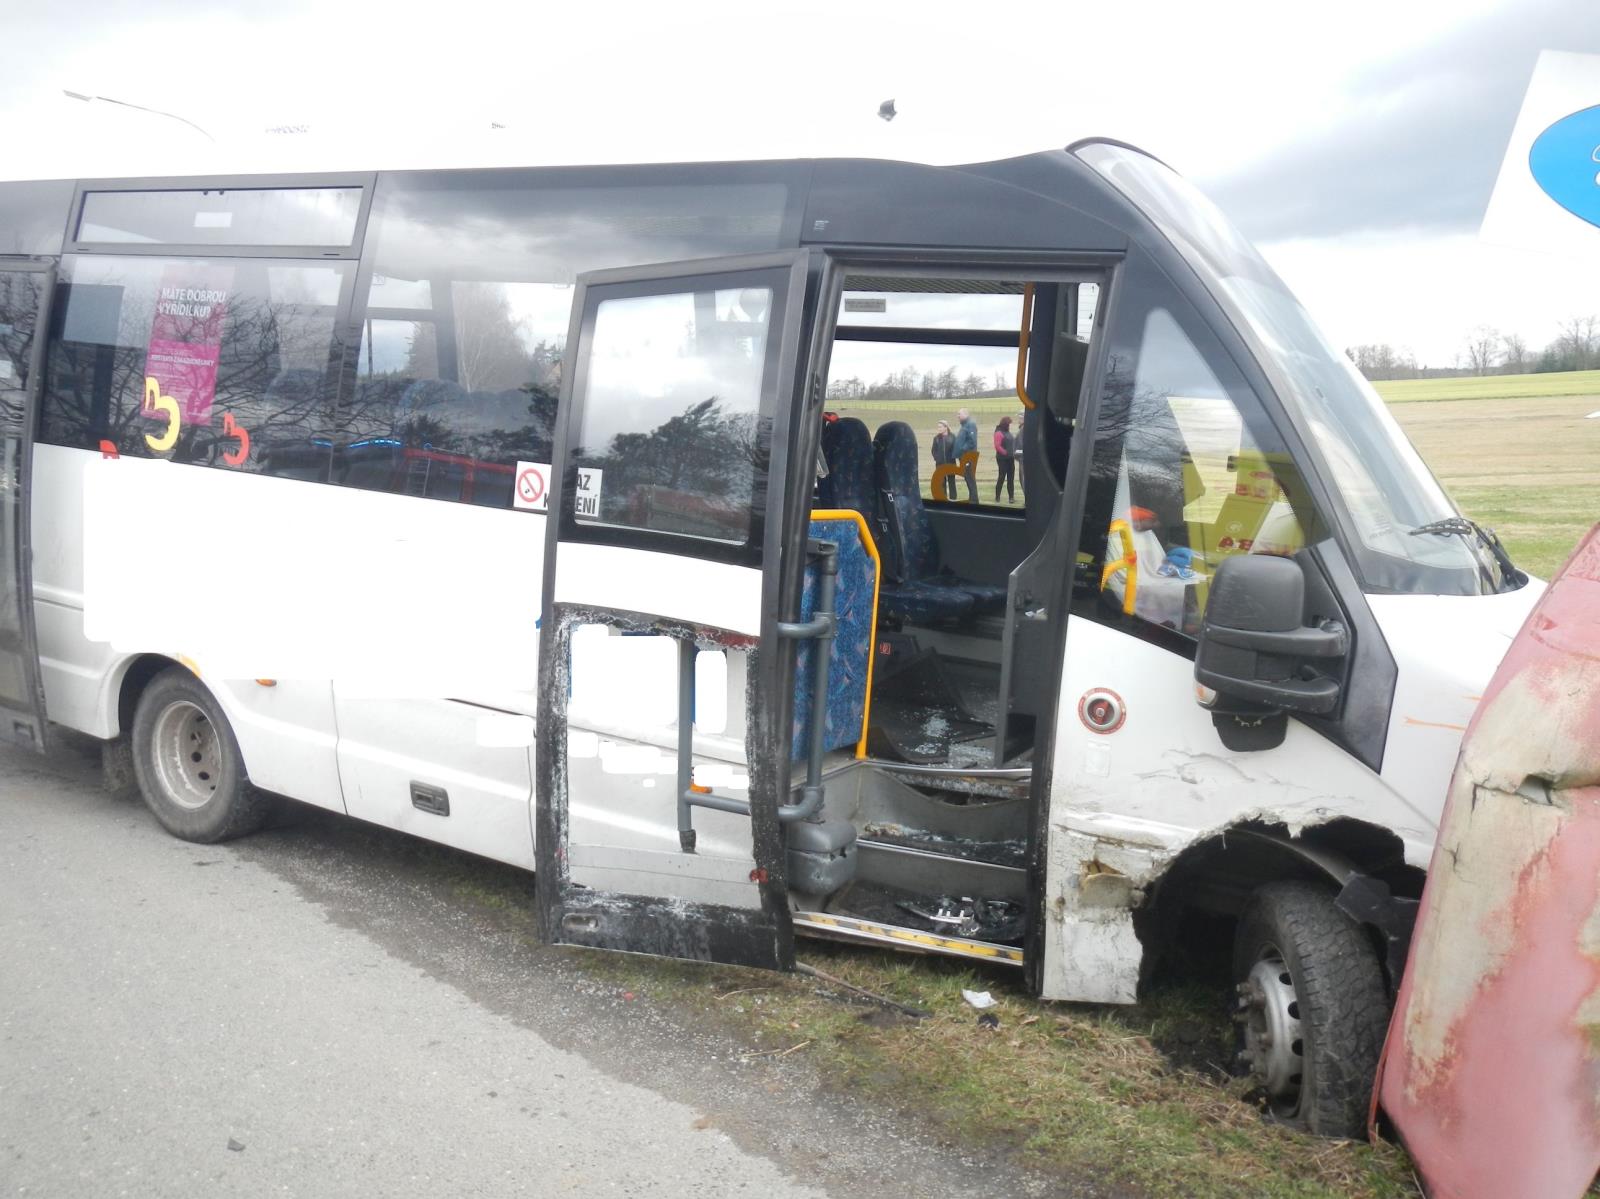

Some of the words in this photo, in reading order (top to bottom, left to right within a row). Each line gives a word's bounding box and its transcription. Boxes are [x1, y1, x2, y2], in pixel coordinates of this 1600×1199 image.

[187, 289, 226, 303] DOBROU
[577, 473, 591, 491] AZ
[575, 494, 598, 515] ENÍ
